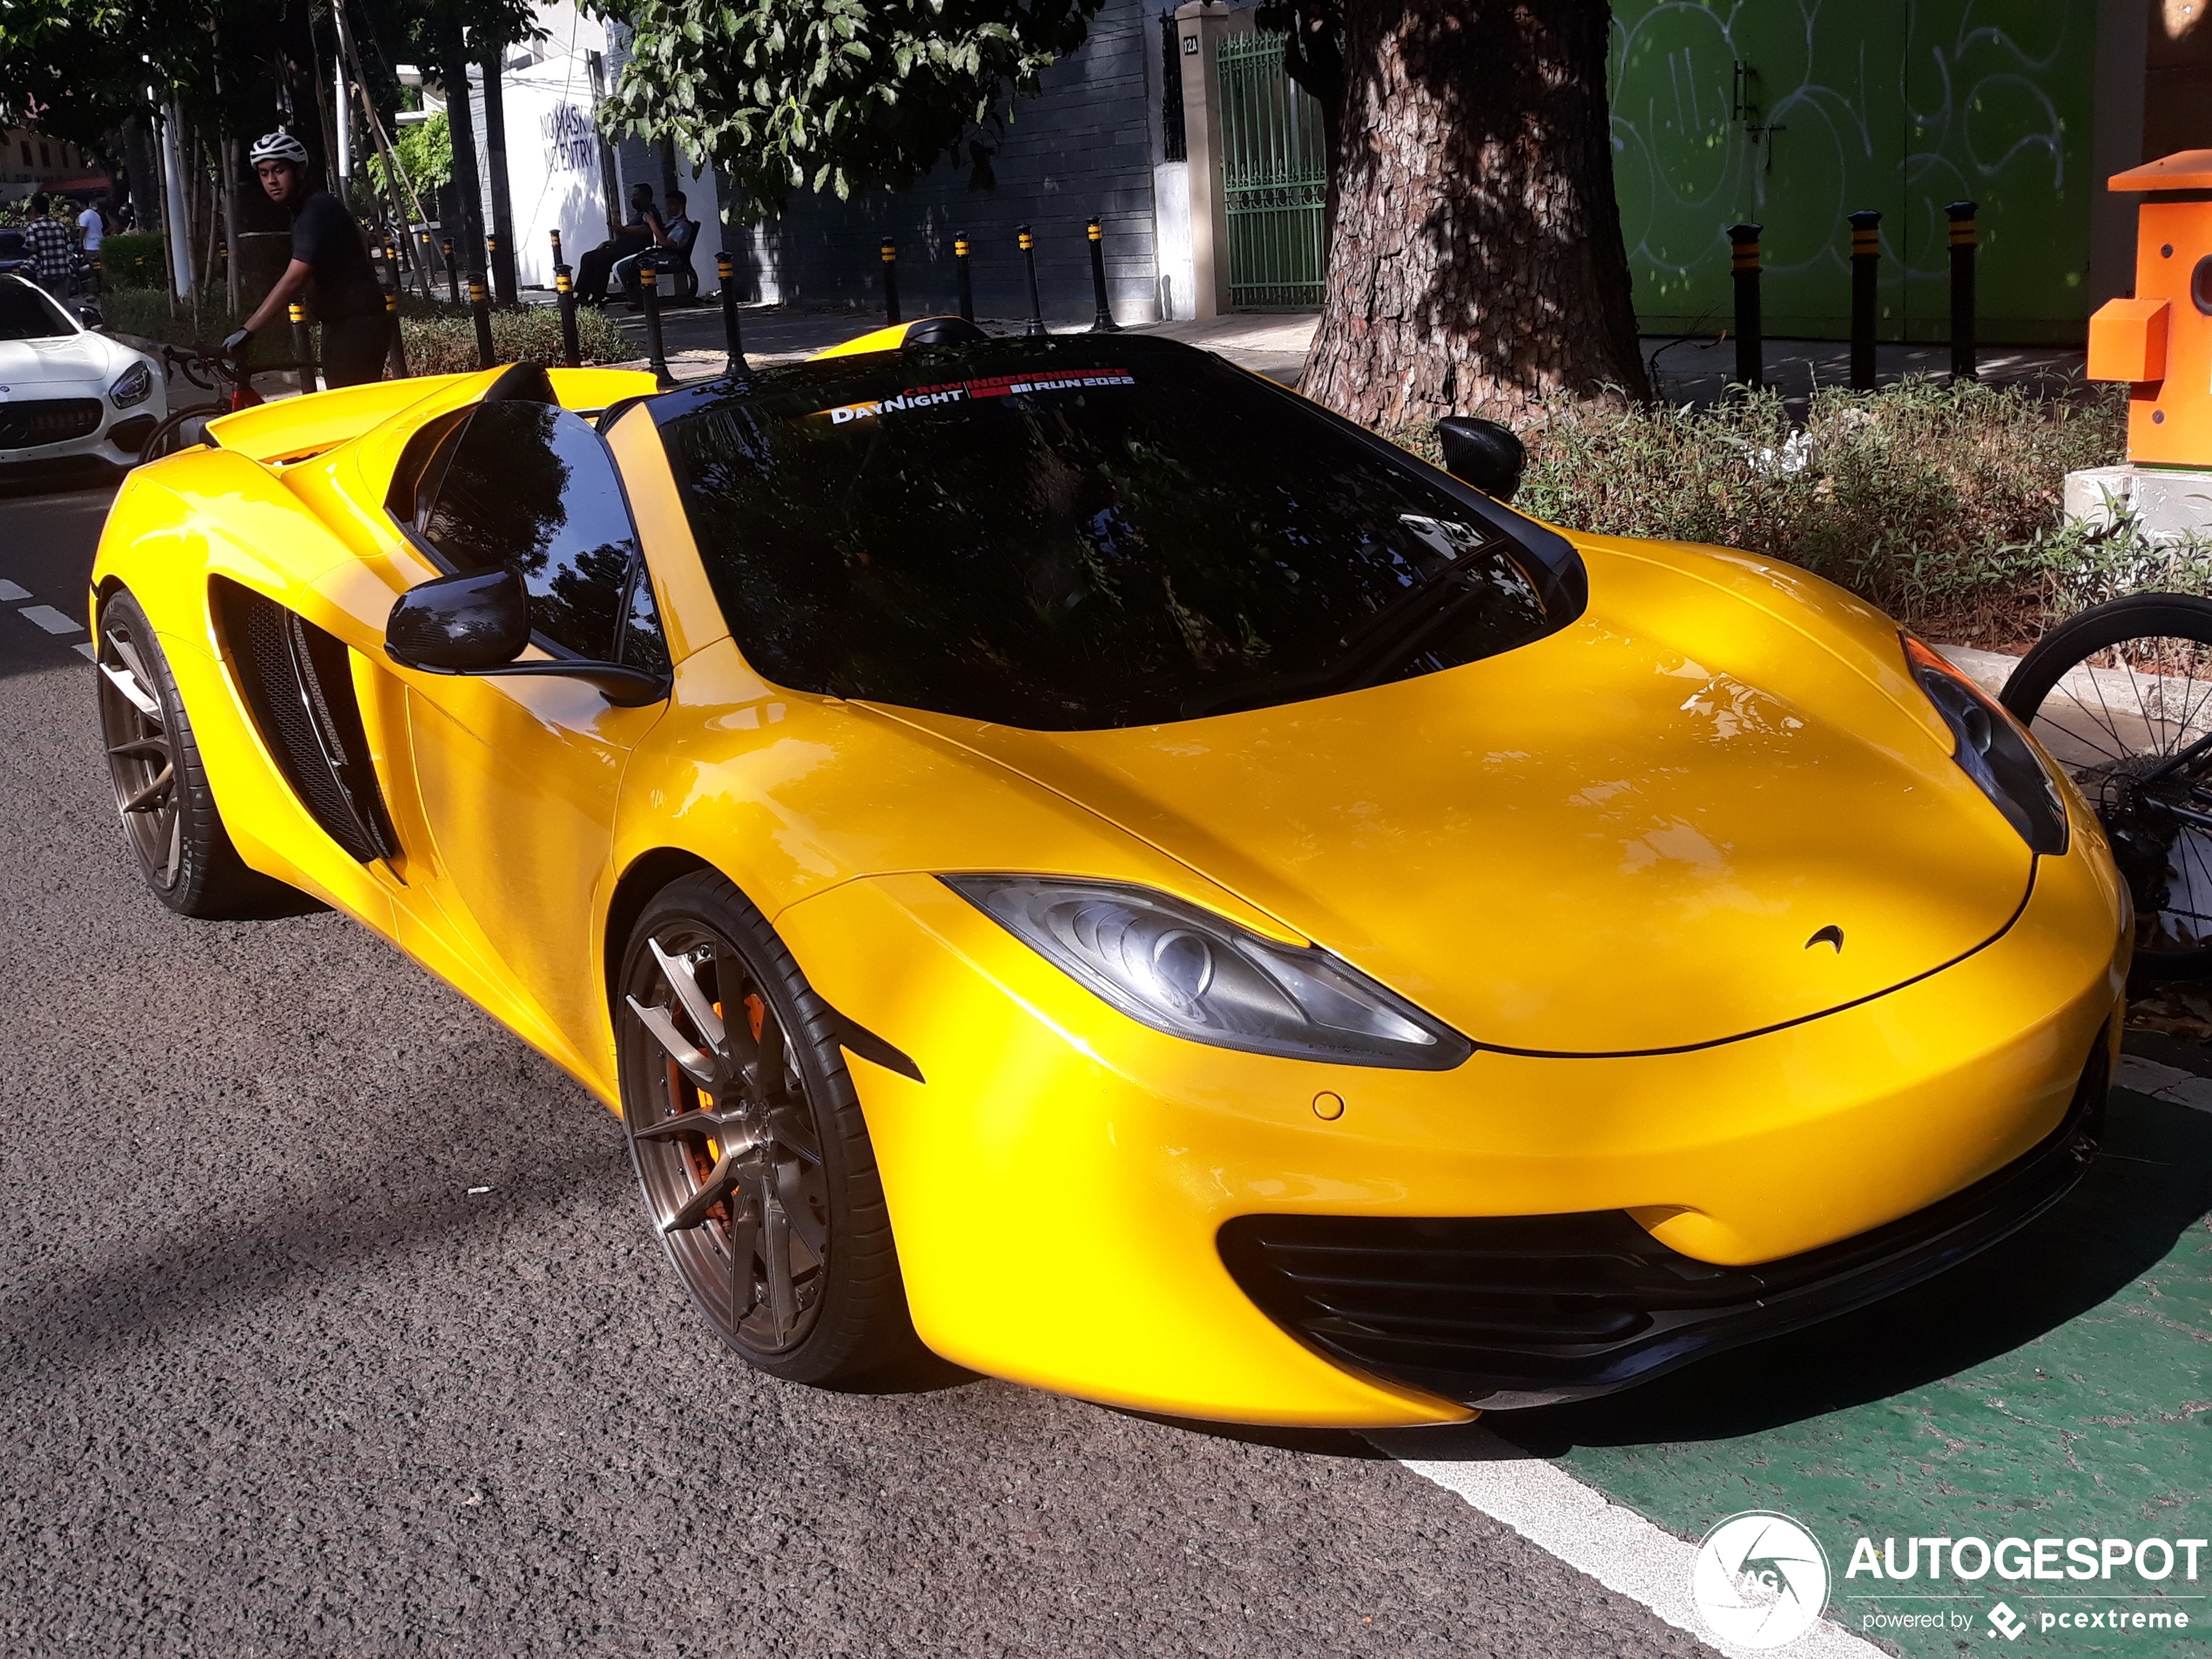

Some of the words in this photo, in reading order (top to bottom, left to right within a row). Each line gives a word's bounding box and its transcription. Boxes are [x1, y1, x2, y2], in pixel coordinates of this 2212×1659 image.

[1184, 37, 1198, 53] 12A
[540, 111, 555, 141] NO
[555, 105, 587, 138] MASK
[543, 145, 559, 174] NO
[559, 137, 593, 172] ENTRY
[966, 368, 1130, 389] INDEPENDENCE
[1034, 379, 1082, 391] RUN
[1082, 375, 1136, 388] 2022
[902, 381, 962, 397] CREW
